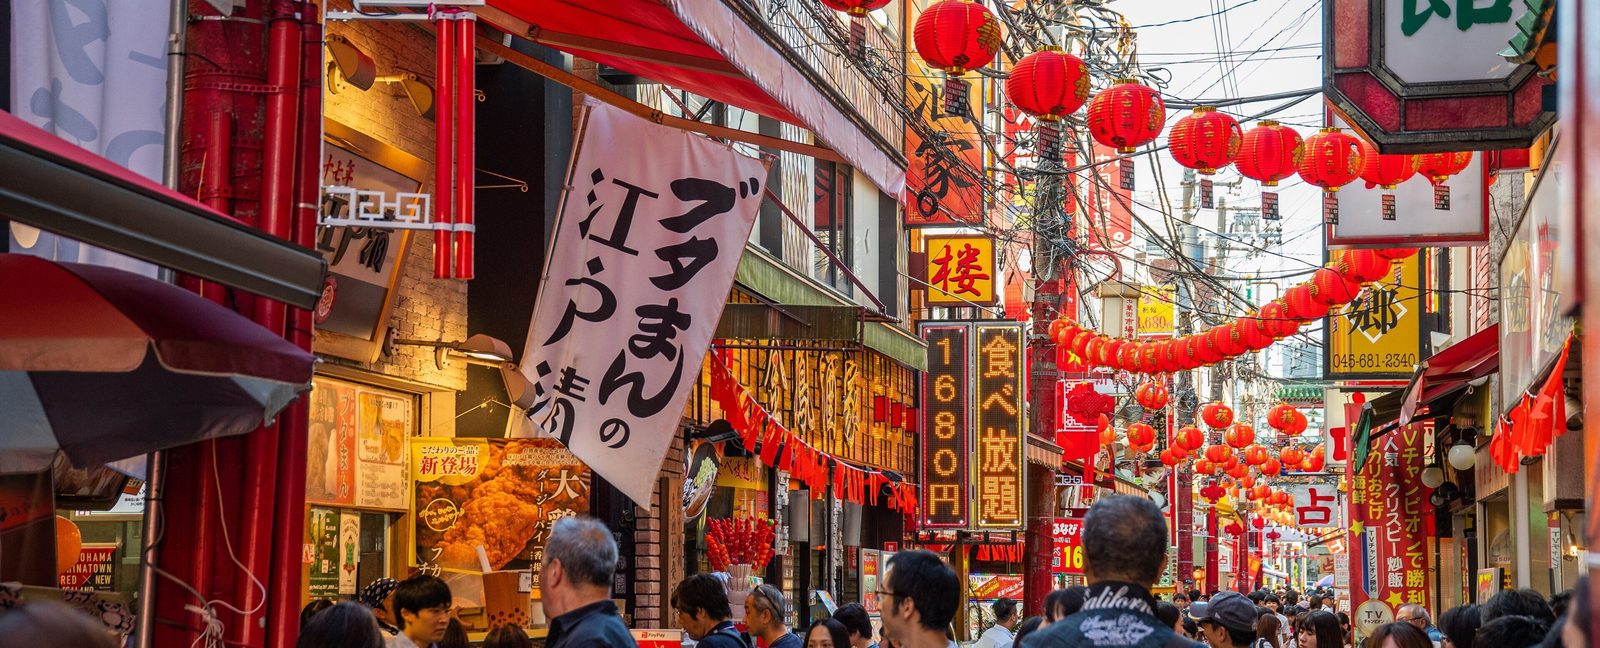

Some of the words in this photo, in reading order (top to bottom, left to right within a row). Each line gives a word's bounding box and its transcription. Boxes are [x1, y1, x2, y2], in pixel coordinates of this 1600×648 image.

[932, 243, 990, 296] 楼
[527, 167, 659, 450] 江戸清
[598, 176, 759, 449] ブタまんの
[1347, 288, 1399, 335] 郷
[1333, 353, 1416, 368] 045-681-2340
[929, 338, 960, 516] 1680円
[982, 335, 1017, 520] 食べ放題
[419, 456, 477, 475] 新登場
[1296, 488, 1335, 525] 占
[1384, 429, 1404, 588] 人気・クリスピー炒飯
[1402, 424, 1427, 607] Vチャンピオンで勝利
[60, 575, 77, 585] RED
[95, 575, 111, 585] NEW
[76, 552, 112, 562] OHAMA
[1365, 611, 1382, 619] TV
